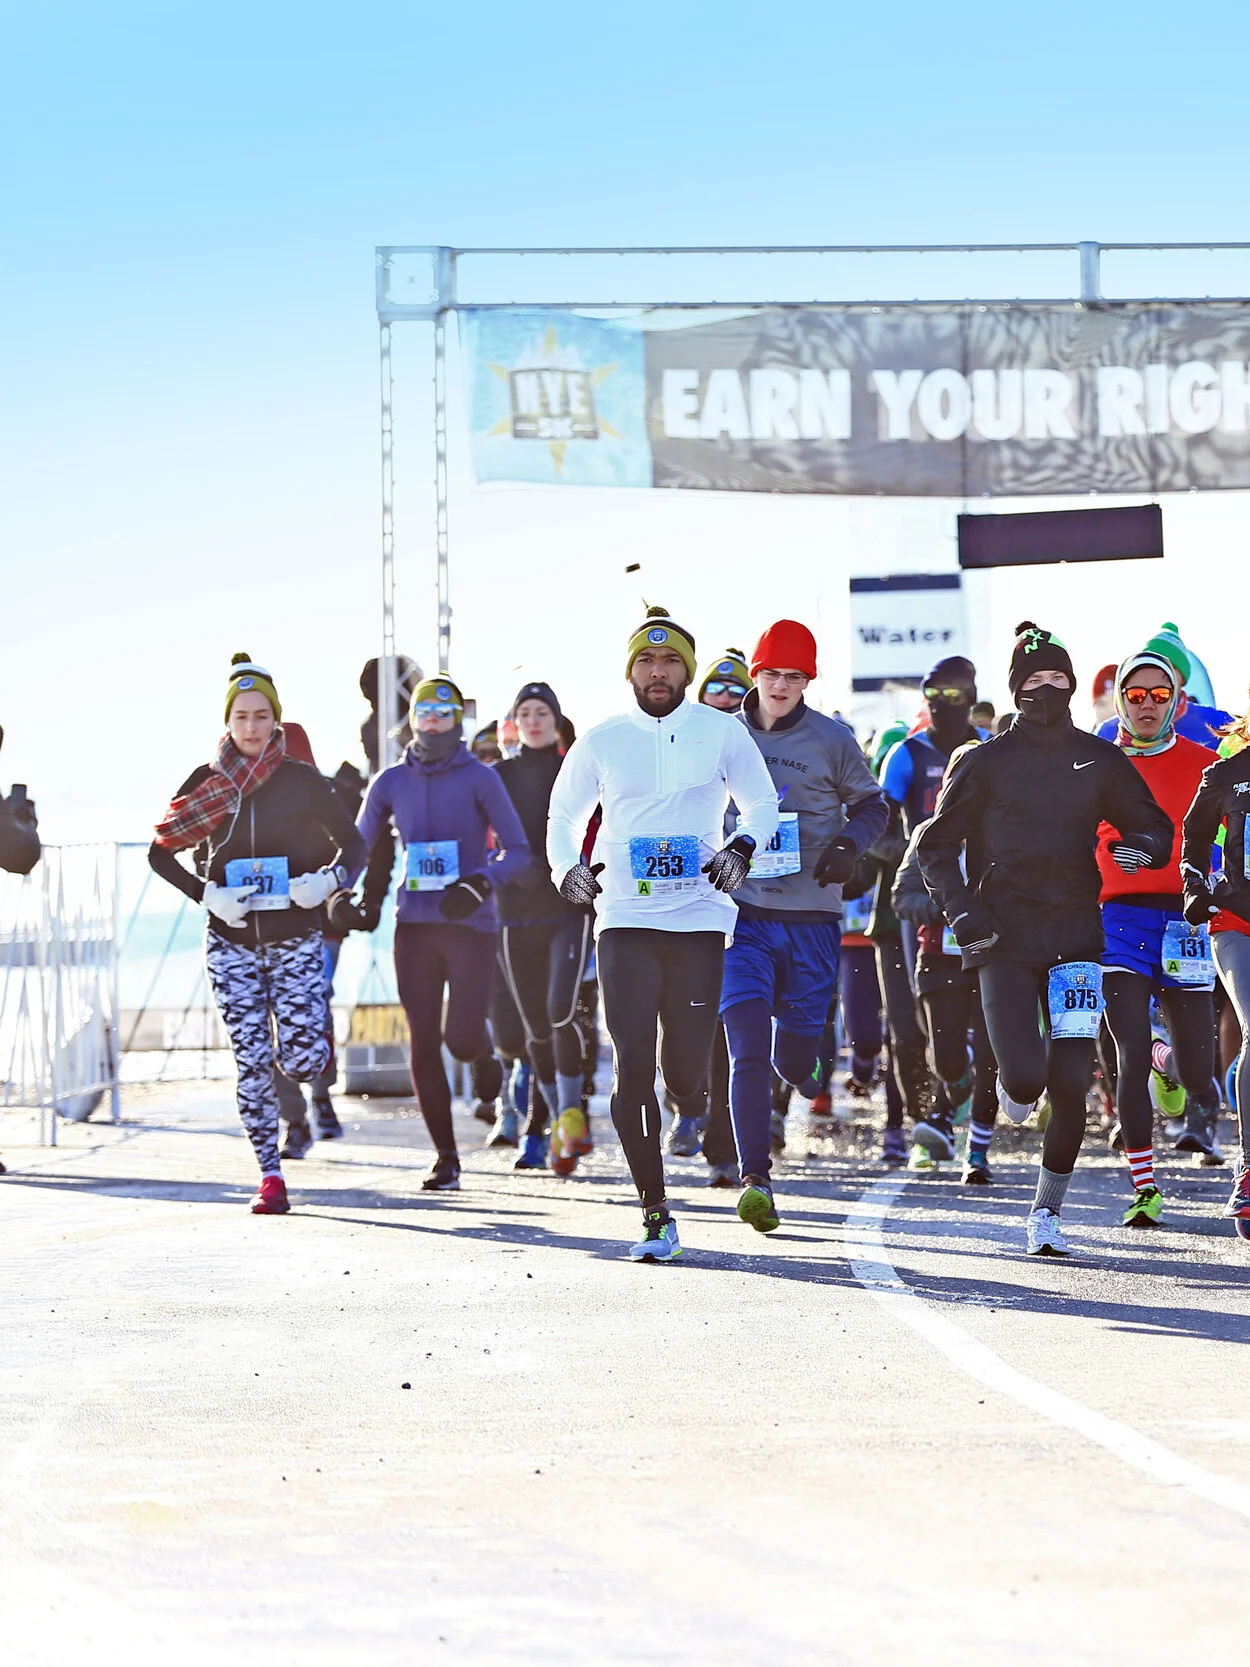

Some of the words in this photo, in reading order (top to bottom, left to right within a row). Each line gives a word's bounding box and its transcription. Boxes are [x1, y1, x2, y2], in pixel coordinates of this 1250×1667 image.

[662, 368, 852, 440] EARN
[872, 367, 1077, 441] YOUR
[418, 858, 445, 876] 106
[645, 855, 683, 877] 253
[639, 882, 649, 894] A
[1178, 938, 1205, 958] 131
[1168, 961, 1178, 972] A
[1064, 988, 1098, 1010] 875
